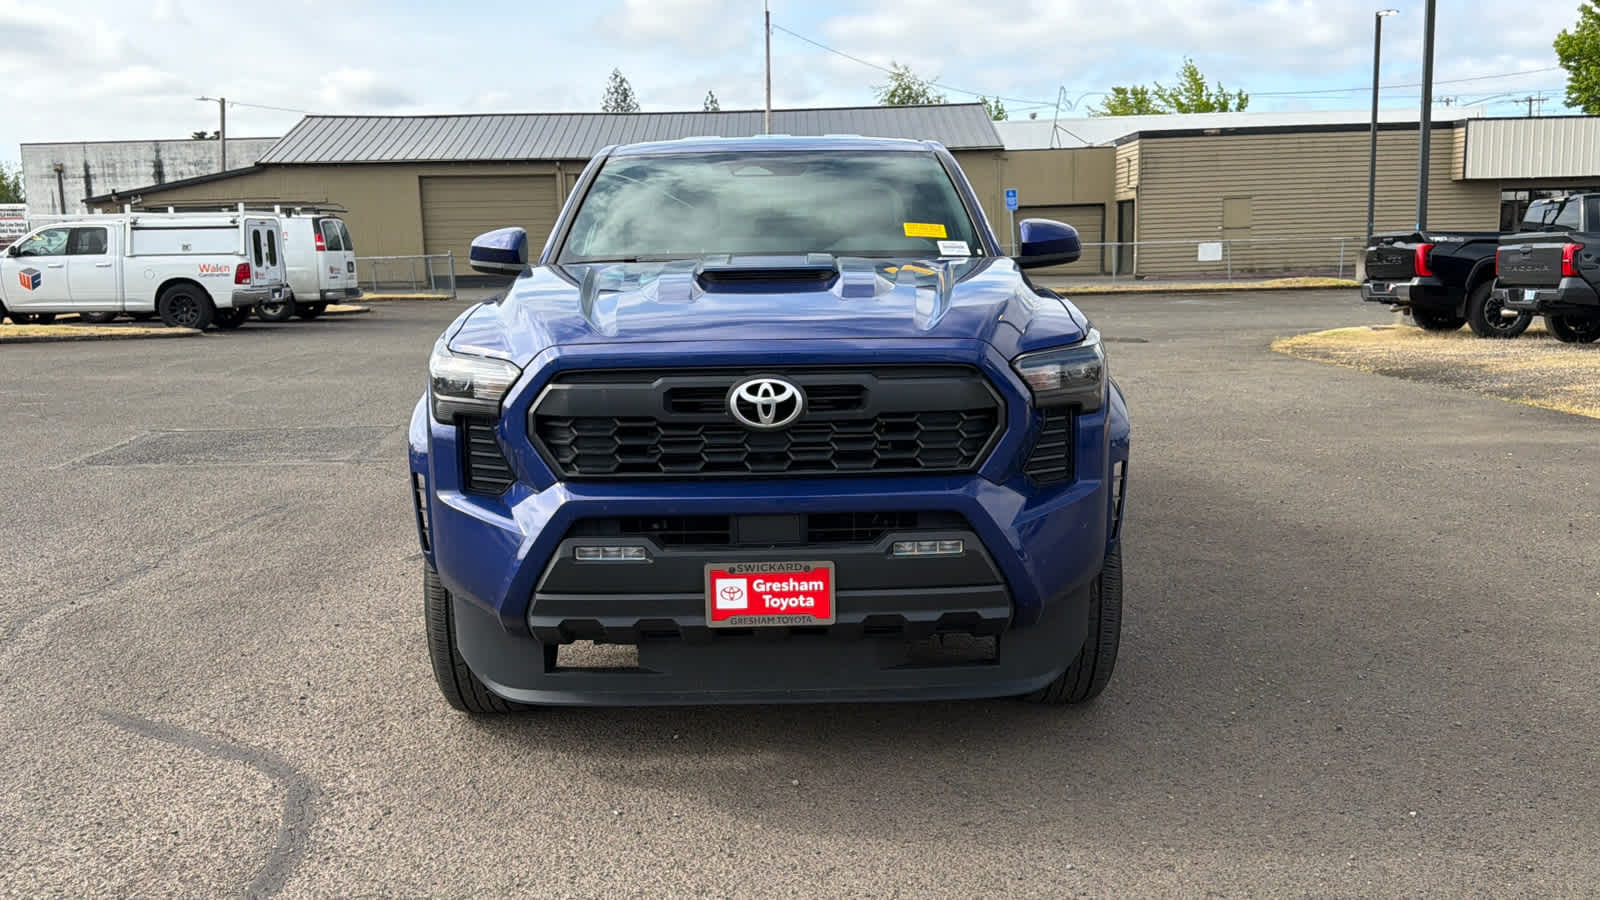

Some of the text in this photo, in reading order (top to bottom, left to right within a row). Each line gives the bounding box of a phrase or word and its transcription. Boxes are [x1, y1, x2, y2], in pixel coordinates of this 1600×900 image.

[198, 264, 230, 272] Walen
[736, 563, 802, 573] SWICKARD
[752, 578, 824, 592] Gresham
[762, 594, 815, 610] Toyota
[730, 616, 812, 625] GRESHAM TOYOTA
